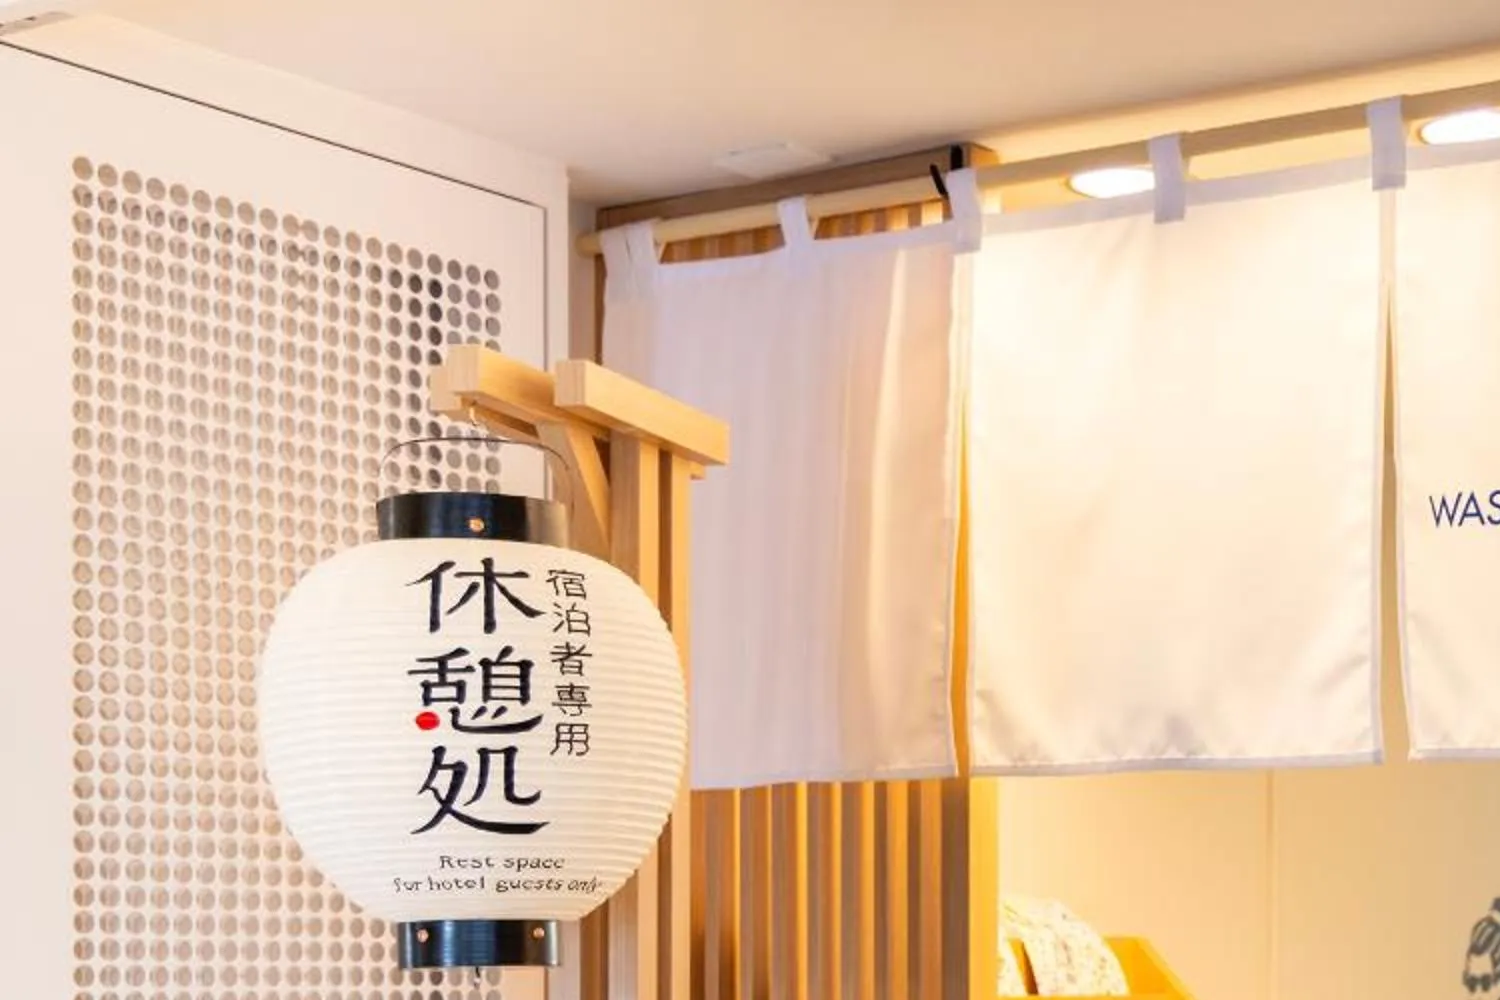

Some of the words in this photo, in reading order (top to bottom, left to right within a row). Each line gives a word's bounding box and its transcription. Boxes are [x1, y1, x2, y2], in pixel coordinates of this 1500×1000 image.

[405, 556, 550, 836] 休憩処
[545, 567, 593, 758] 宿泊者専用
[393, 876, 422, 893] for
[427, 875, 485, 892] hotel
[495, 878, 563, 893] guests
[439, 855, 495, 870] Rest
[502, 856, 565, 872] space
